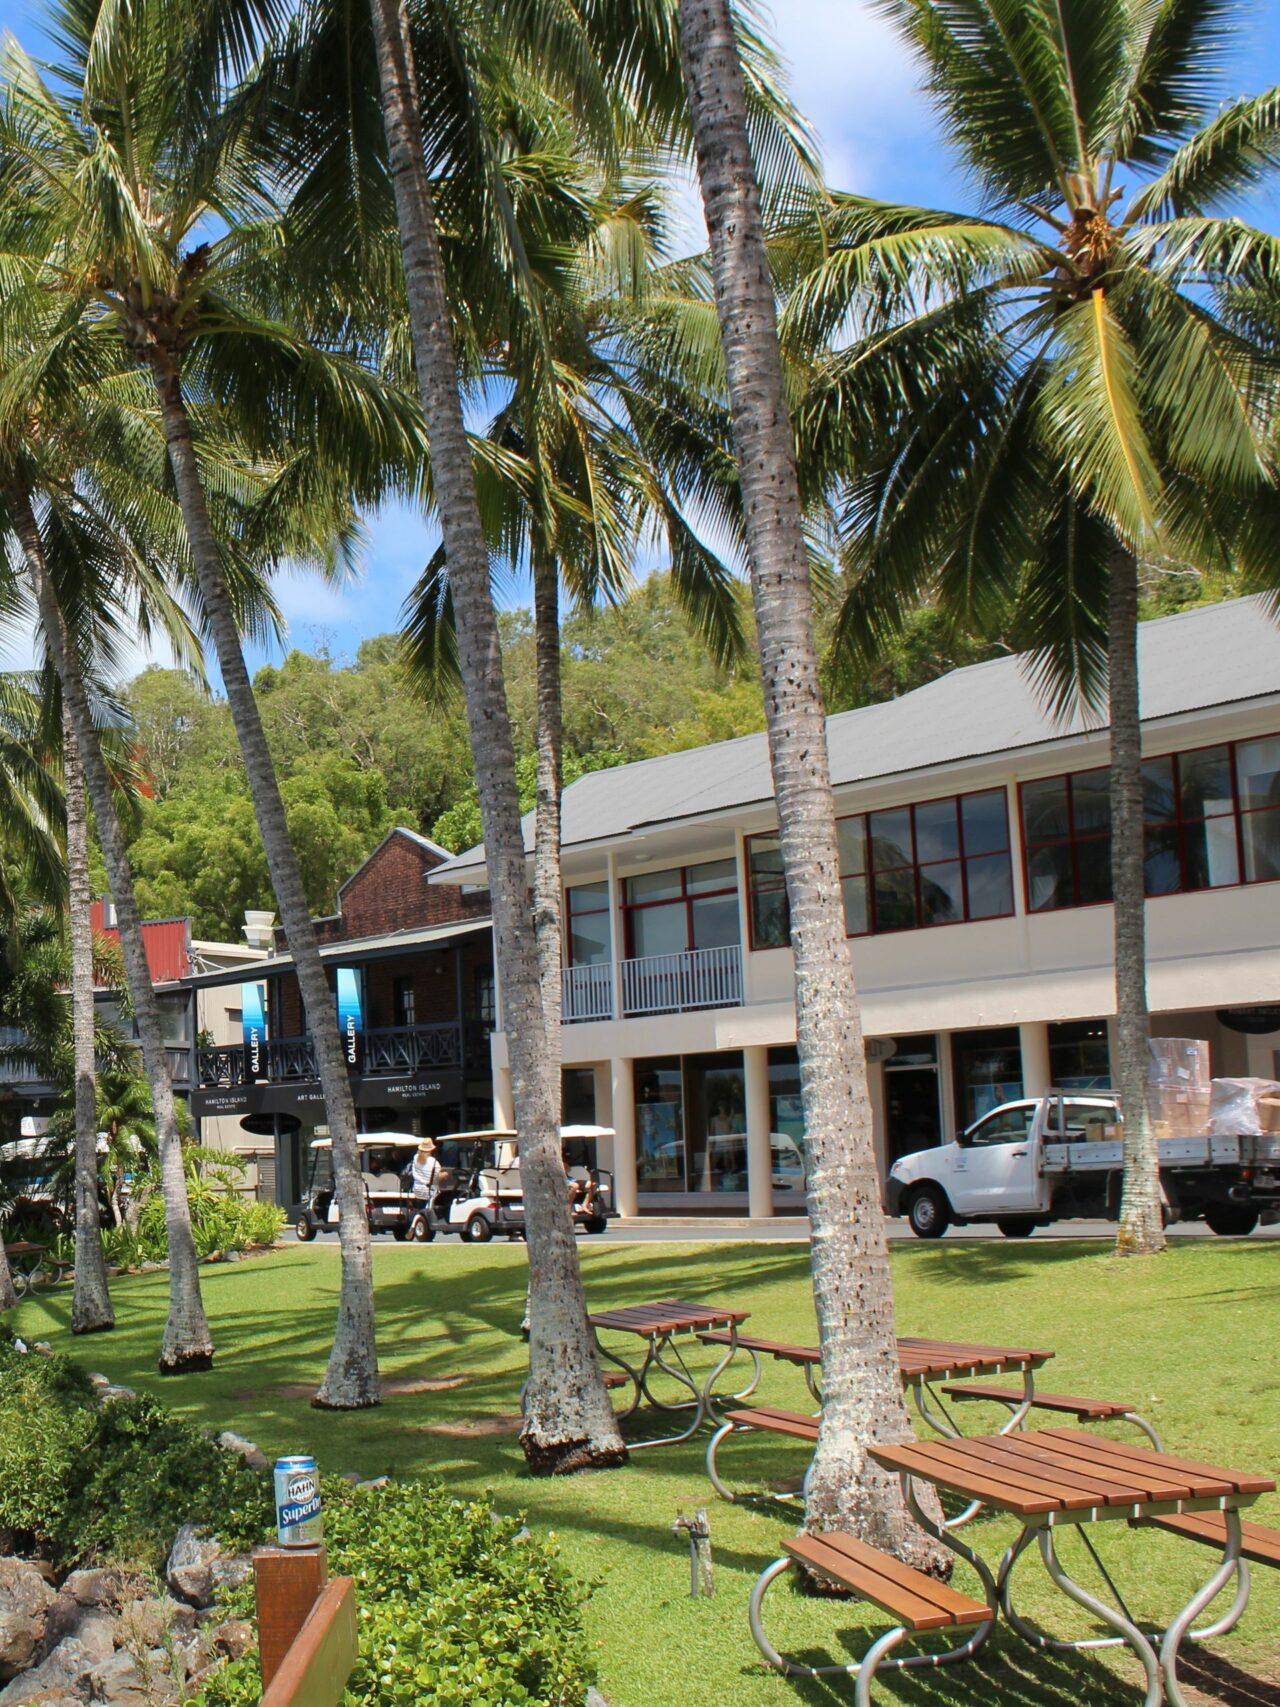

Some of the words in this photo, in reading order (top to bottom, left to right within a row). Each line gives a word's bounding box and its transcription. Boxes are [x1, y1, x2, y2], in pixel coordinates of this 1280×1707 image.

[346, 1014, 356, 1063] GALLERY
[250, 1027, 260, 1073] GALLERY
[387, 1084, 417, 1093] HAMILTON
[418, 1083, 441, 1091] ISLAND
[205, 1097, 228, 1105] HAMILTON
[229, 1096, 248, 1104] ISLAND
[288, 1481, 315, 1498] HAHN
